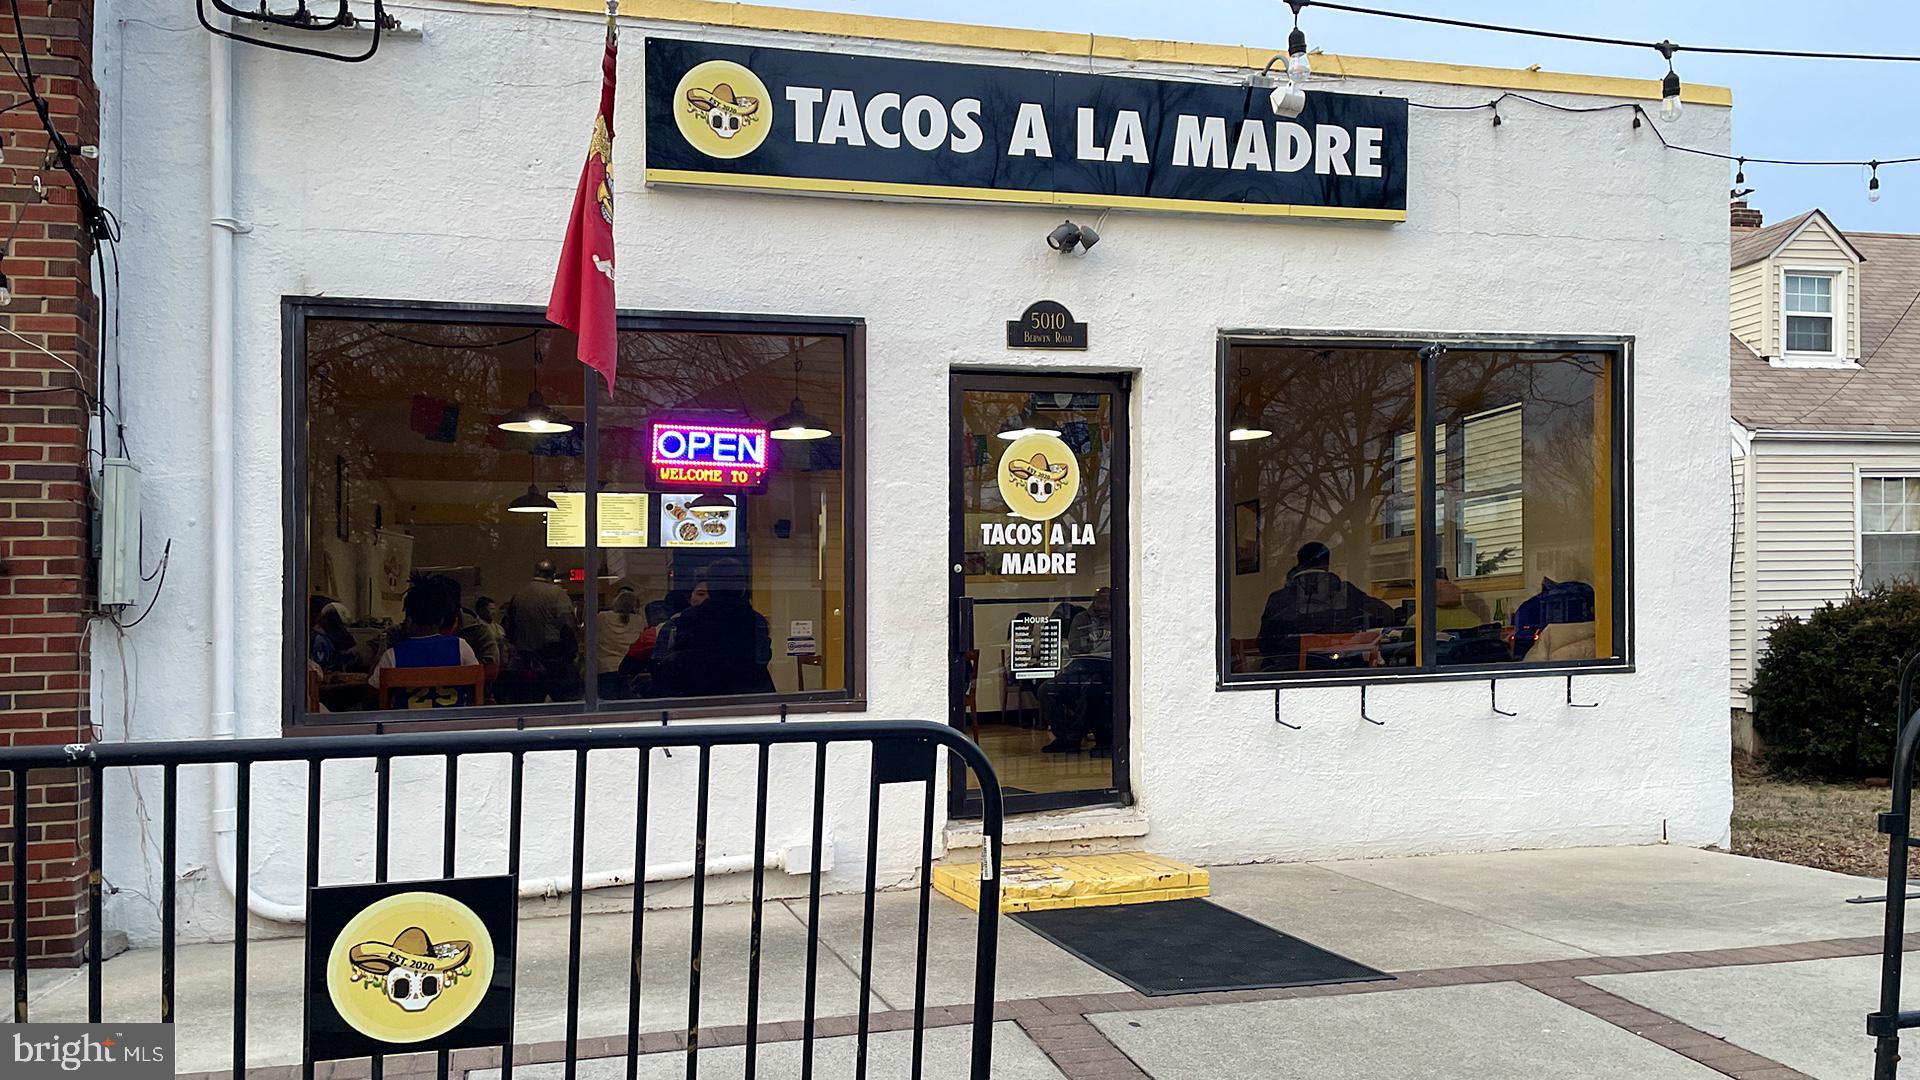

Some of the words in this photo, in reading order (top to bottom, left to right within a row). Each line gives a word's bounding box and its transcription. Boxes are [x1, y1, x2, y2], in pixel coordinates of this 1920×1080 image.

[722, 105, 738, 115] 2020
[785, 85, 984, 154] TACOS
[1007, 102, 1053, 158] A
[1076, 106, 1150, 164] LA
[1171, 113, 1384, 178] MADRE
[1031, 312, 1065, 330] 5010
[657, 430, 762, 463] OPEN
[660, 467, 722, 483] WELCOME
[731, 470, 749, 484] TO
[980, 523, 1043, 545] TACOS
[1049, 523, 1065, 545] A
[1071, 523, 1096, 545] LA
[1001, 552, 1077, 575] MADRE
[1024, 616, 1049, 624] HOURS
[387, 951, 408, 967] EST.
[410, 959, 435, 972] 2020
